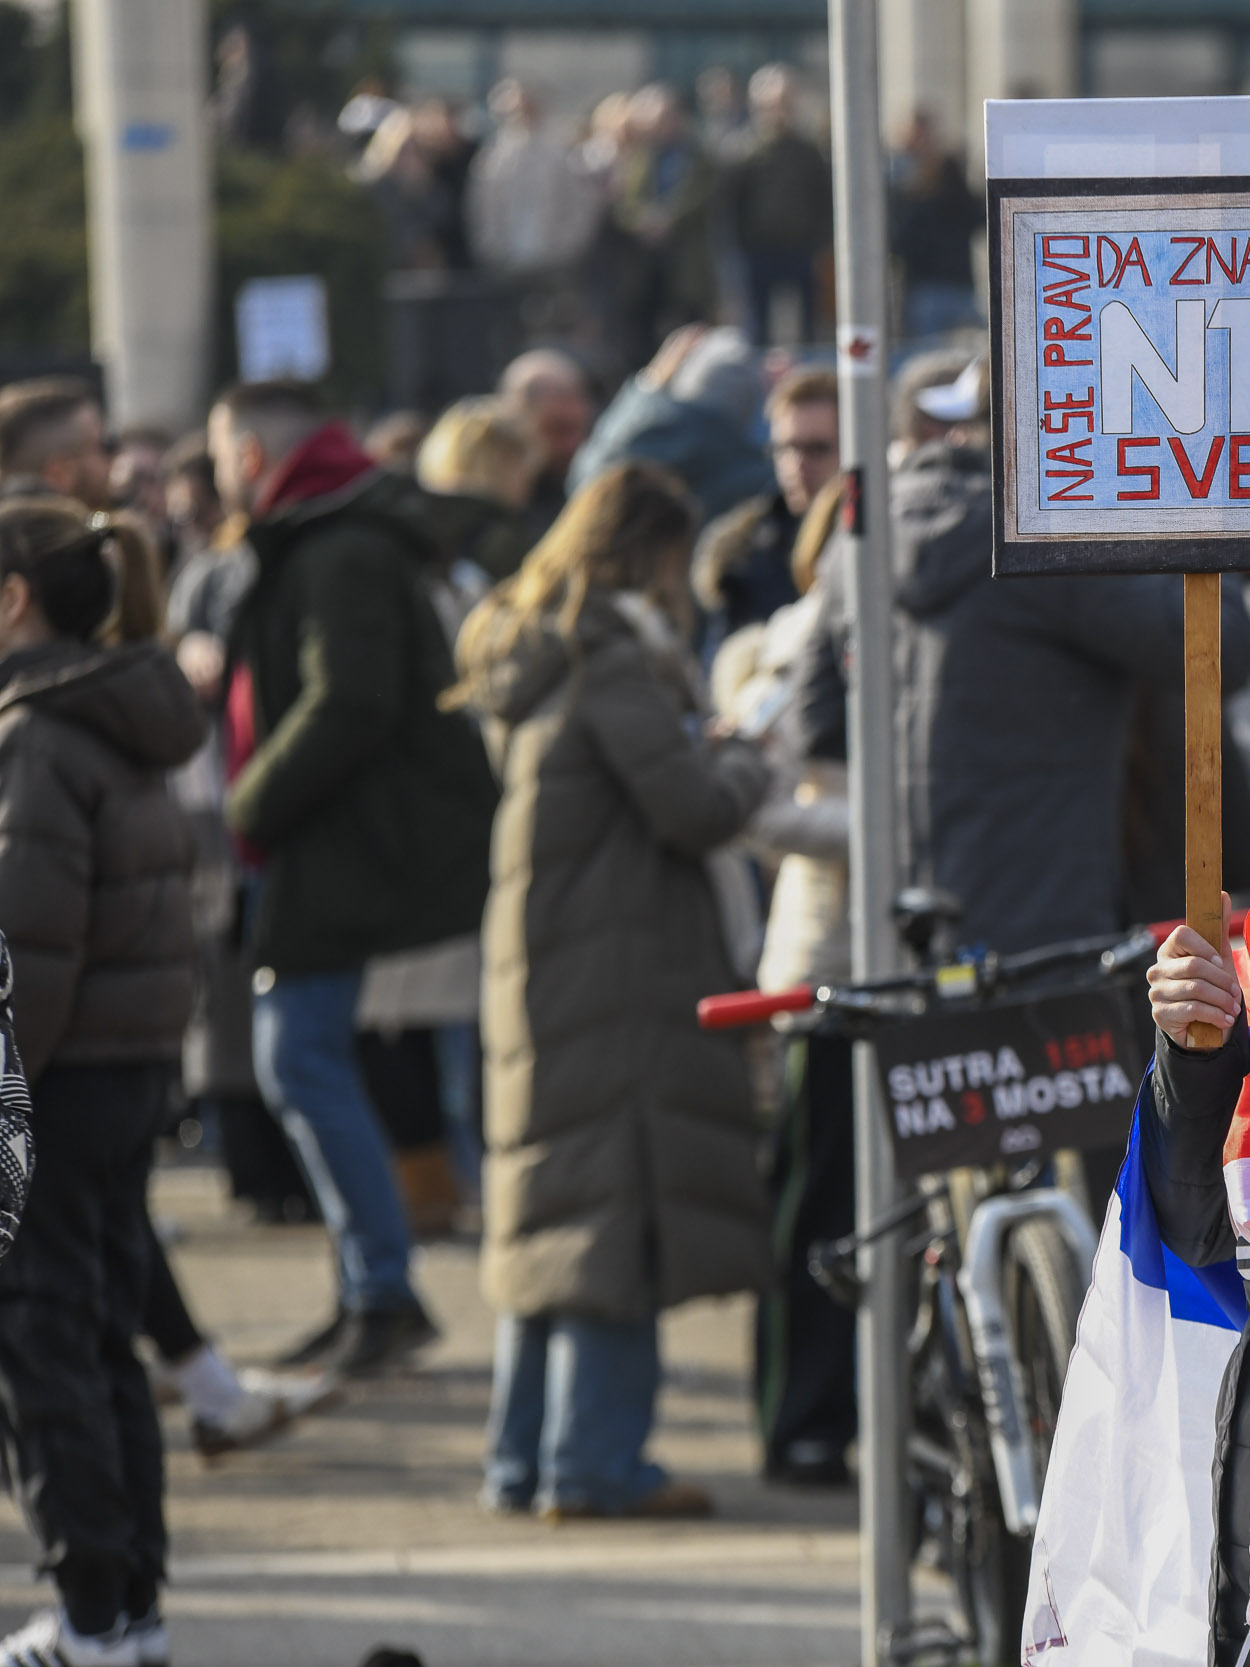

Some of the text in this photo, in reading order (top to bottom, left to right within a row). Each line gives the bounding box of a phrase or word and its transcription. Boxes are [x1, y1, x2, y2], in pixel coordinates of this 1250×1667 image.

[1098, 235, 1152, 288] DA
[1040, 235, 1094, 501] NAŠE PRAVO
[889, 1046, 1024, 1101] SUTRA
[895, 1099, 956, 1138] NA
[992, 1062, 1132, 1120] MOSTA
